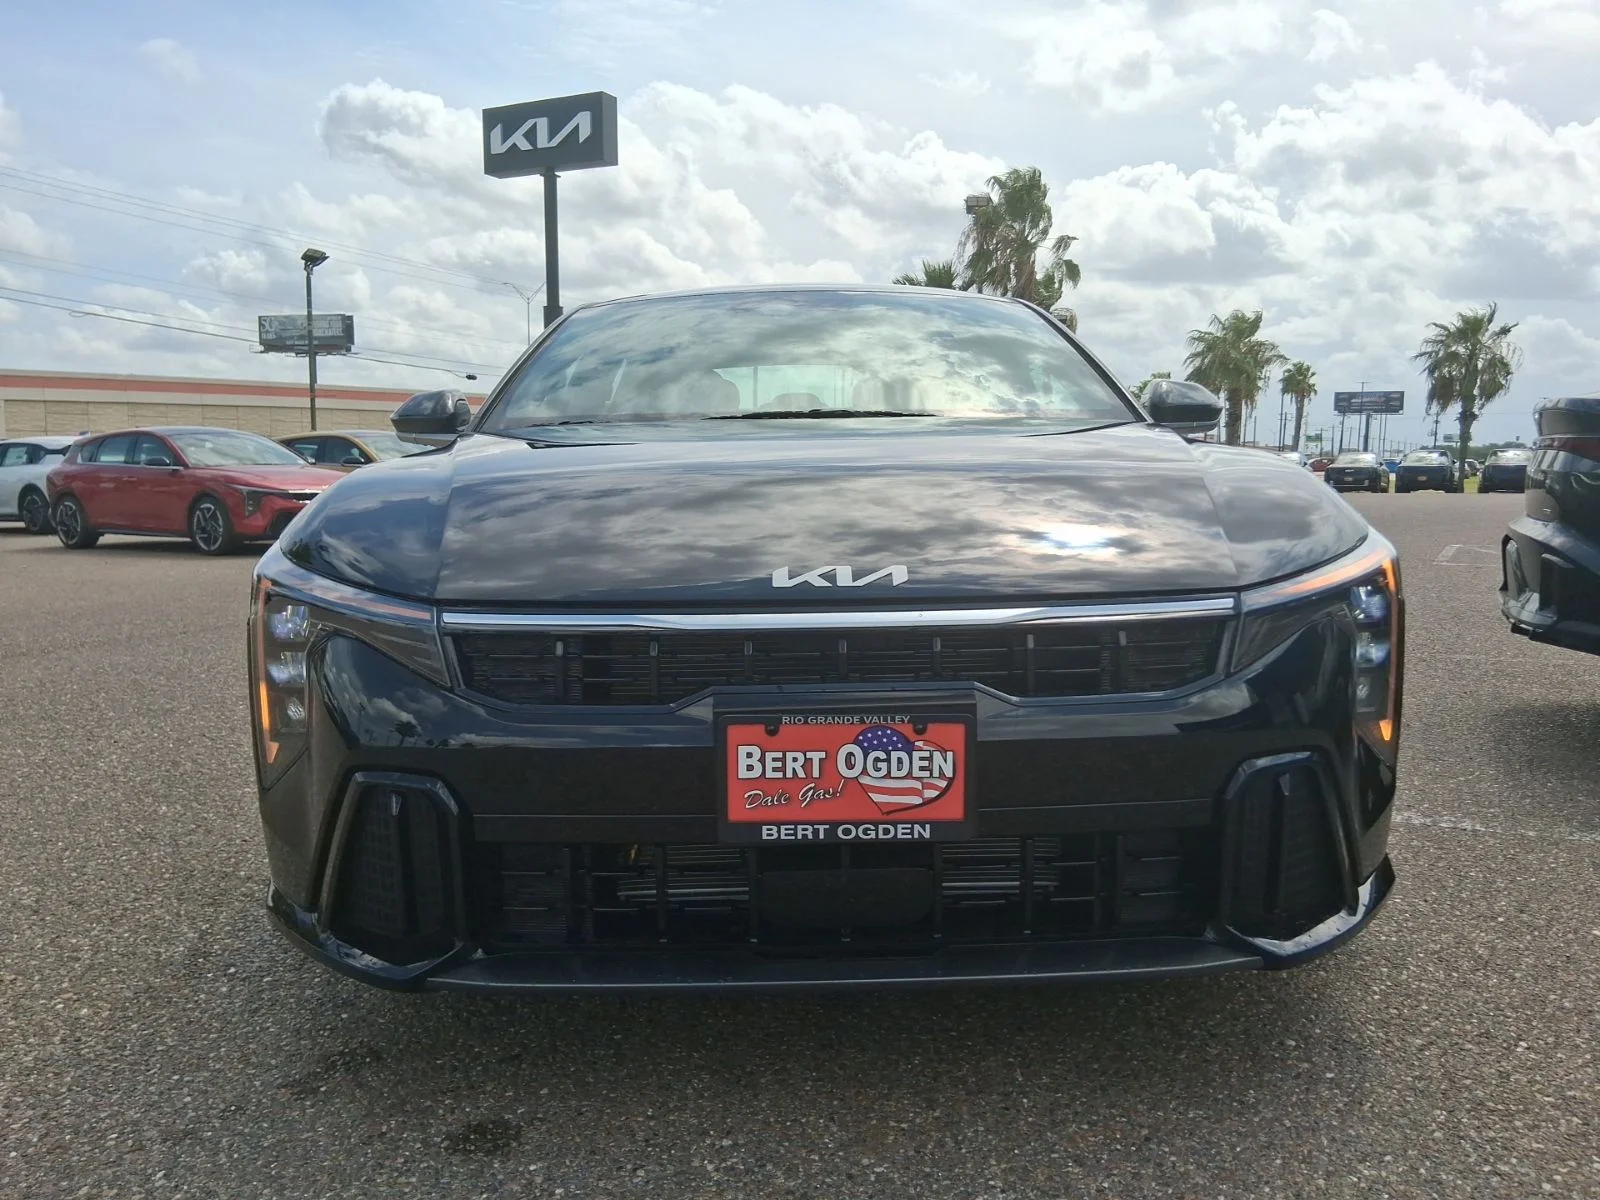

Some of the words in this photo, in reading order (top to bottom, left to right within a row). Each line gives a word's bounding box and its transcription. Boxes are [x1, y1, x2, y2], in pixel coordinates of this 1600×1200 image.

[490, 111, 591, 154] KIA
[772, 565, 909, 588] KIA
[782, 716, 804, 725] RIO
[807, 716, 860, 724] GRANDE
[863, 715, 911, 724] VALLEY
[737, 745, 826, 779] BERT
[837, 743, 954, 778] OGDEN
[744, 789, 789, 808] Dale
[798, 779, 845, 808] Gas!
[761, 825, 830, 840] BERT
[837, 824, 931, 839] OGDEN
